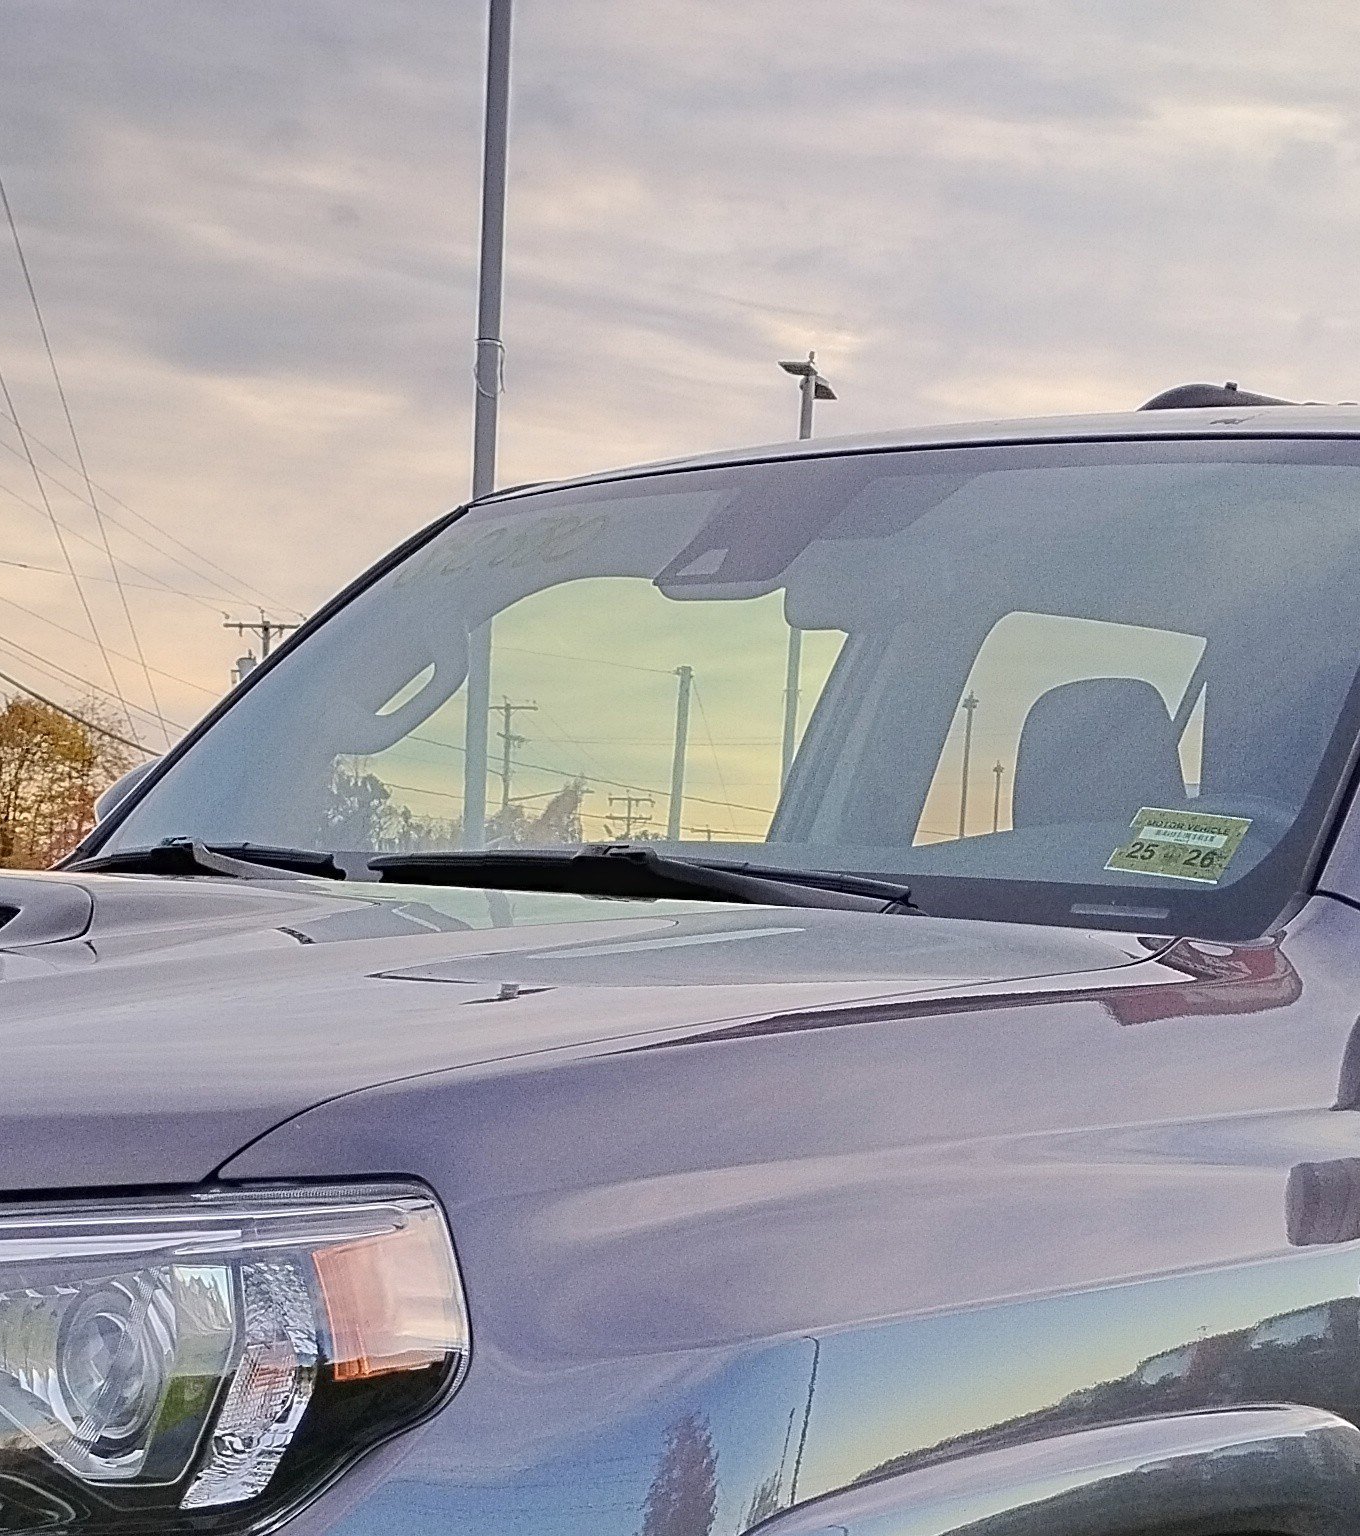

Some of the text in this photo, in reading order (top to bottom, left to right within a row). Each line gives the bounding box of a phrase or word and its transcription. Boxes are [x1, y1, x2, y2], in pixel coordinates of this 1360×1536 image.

[1146, 819, 1185, 831] MOTOR
[1187, 823, 1232, 836] VEHICLE
[1126, 841, 1159, 861] 25
[1183, 849, 1218, 869] 26
